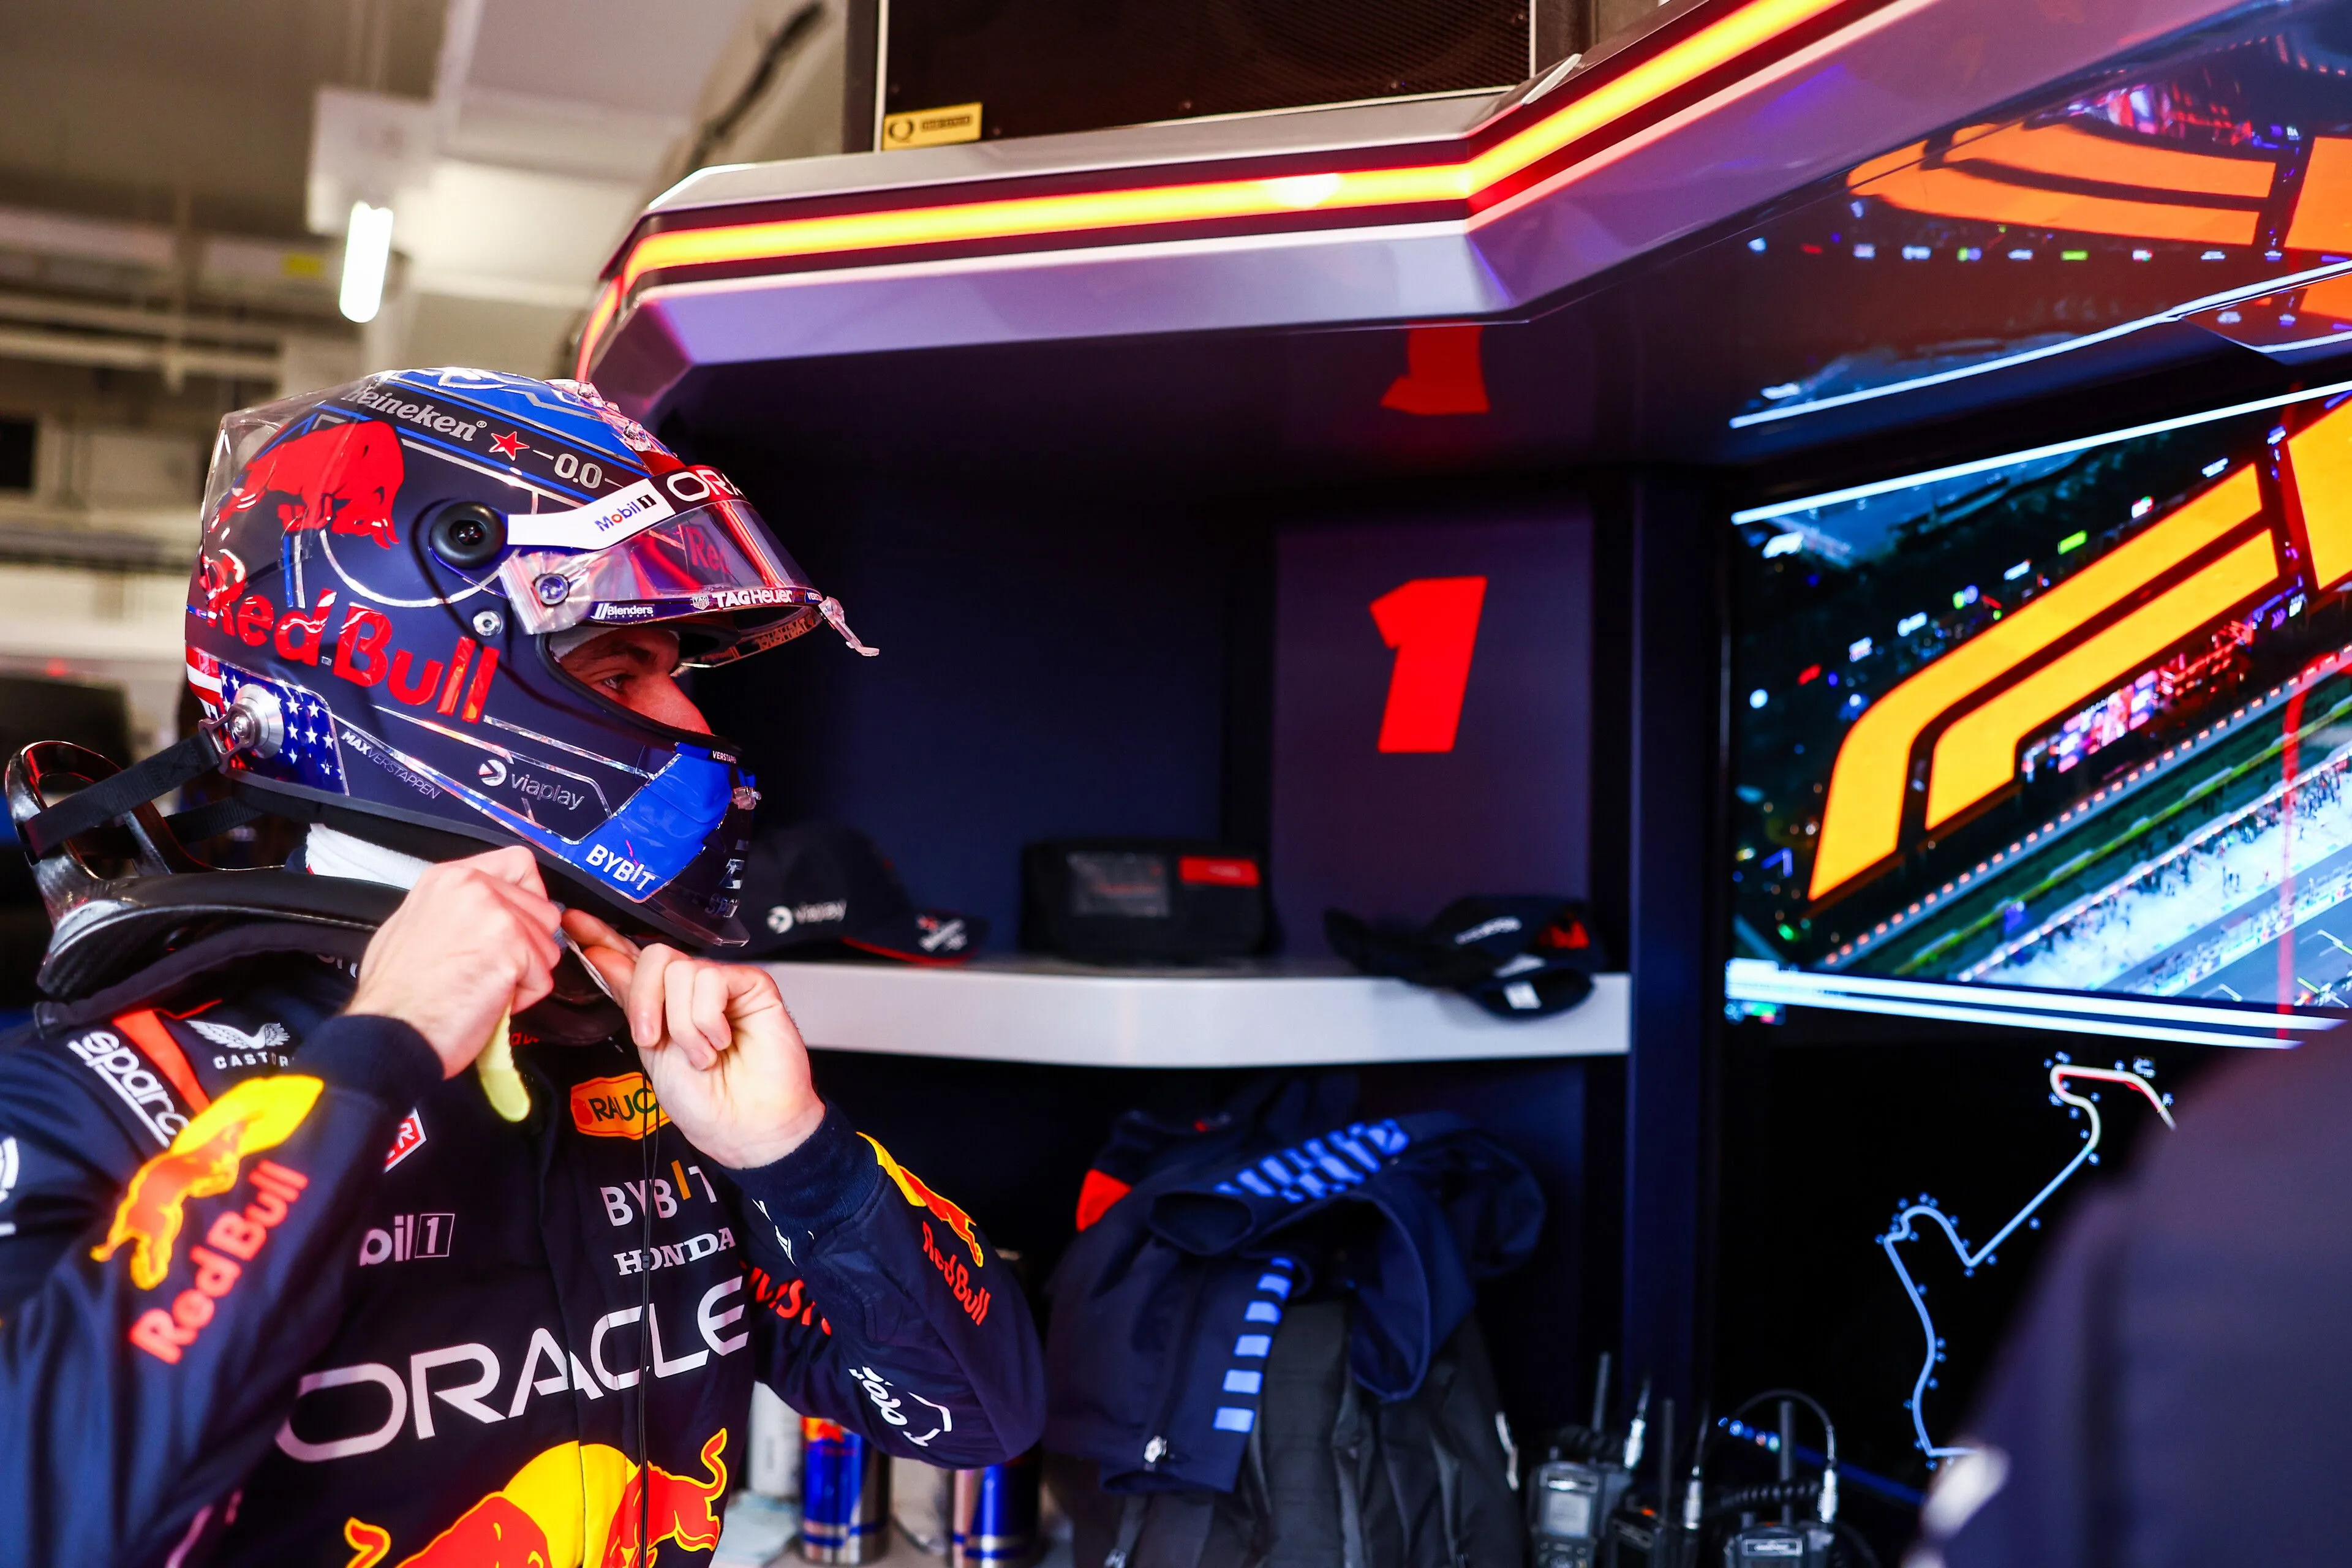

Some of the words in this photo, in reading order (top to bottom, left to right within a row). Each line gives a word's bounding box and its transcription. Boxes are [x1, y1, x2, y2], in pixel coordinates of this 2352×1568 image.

[341, 388, 474, 442] Heineken
[594, 501, 641, 532] Mobil
[639, 496, 655, 508] 1
[199, 549, 337, 666] Red
[332, 601, 500, 725] Bull
[607, 605, 654, 616] Blenders
[1369, 576, 1488, 753] 1
[510, 773, 585, 811] viaplay
[585, 843, 656, 891] BYBIT
[81, 1031, 190, 1136] sparc
[213, 1051, 289, 1070] CASTOR
[588, 1087, 656, 1122] RAUC
[600, 1159, 717, 1227] BYBIT
[129, 1245, 242, 1364] Red
[206, 1159, 309, 1261] Bull
[613, 1226, 736, 1276] HONDA
[922, 1221, 957, 1286] Red
[954, 1264, 991, 1326] Bull
[276, 1276, 749, 1463] ORACLE
